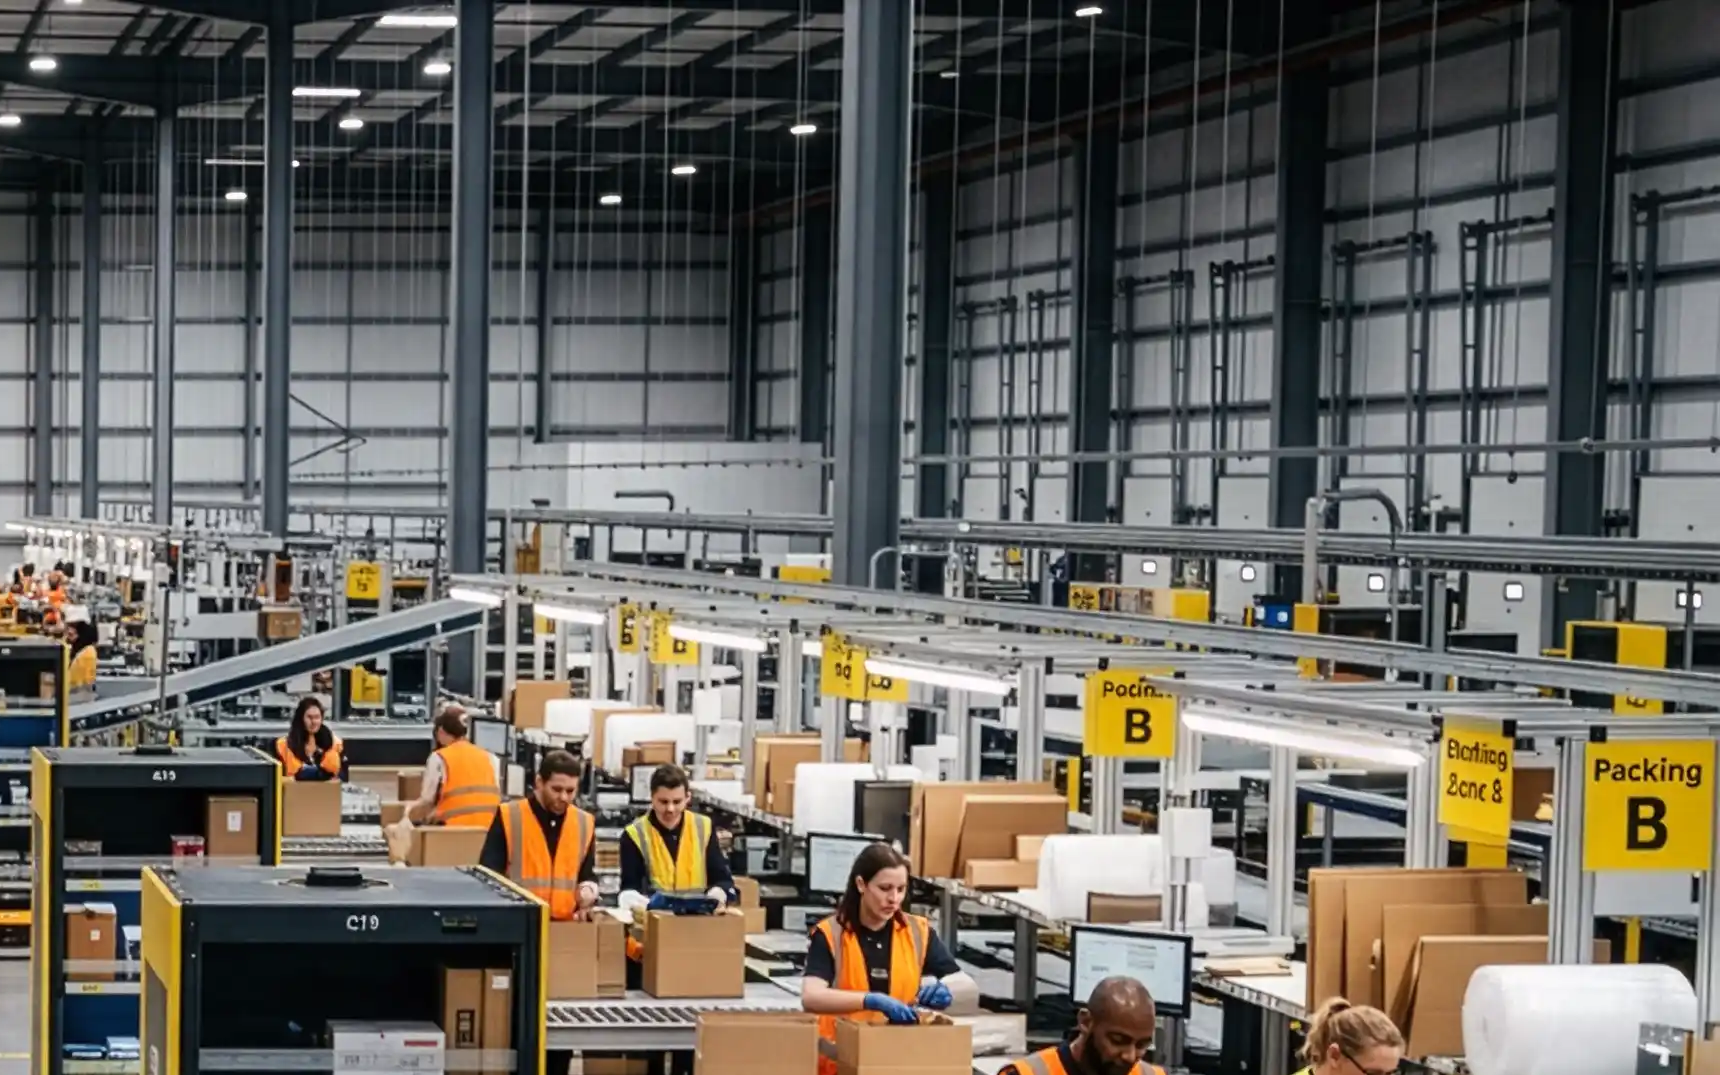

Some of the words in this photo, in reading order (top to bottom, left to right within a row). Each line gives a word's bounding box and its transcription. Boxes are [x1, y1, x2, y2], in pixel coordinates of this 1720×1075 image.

[1124, 708, 1152, 744] B
[1593, 757, 1702, 788] Packing
[1626, 796, 1668, 850] B
